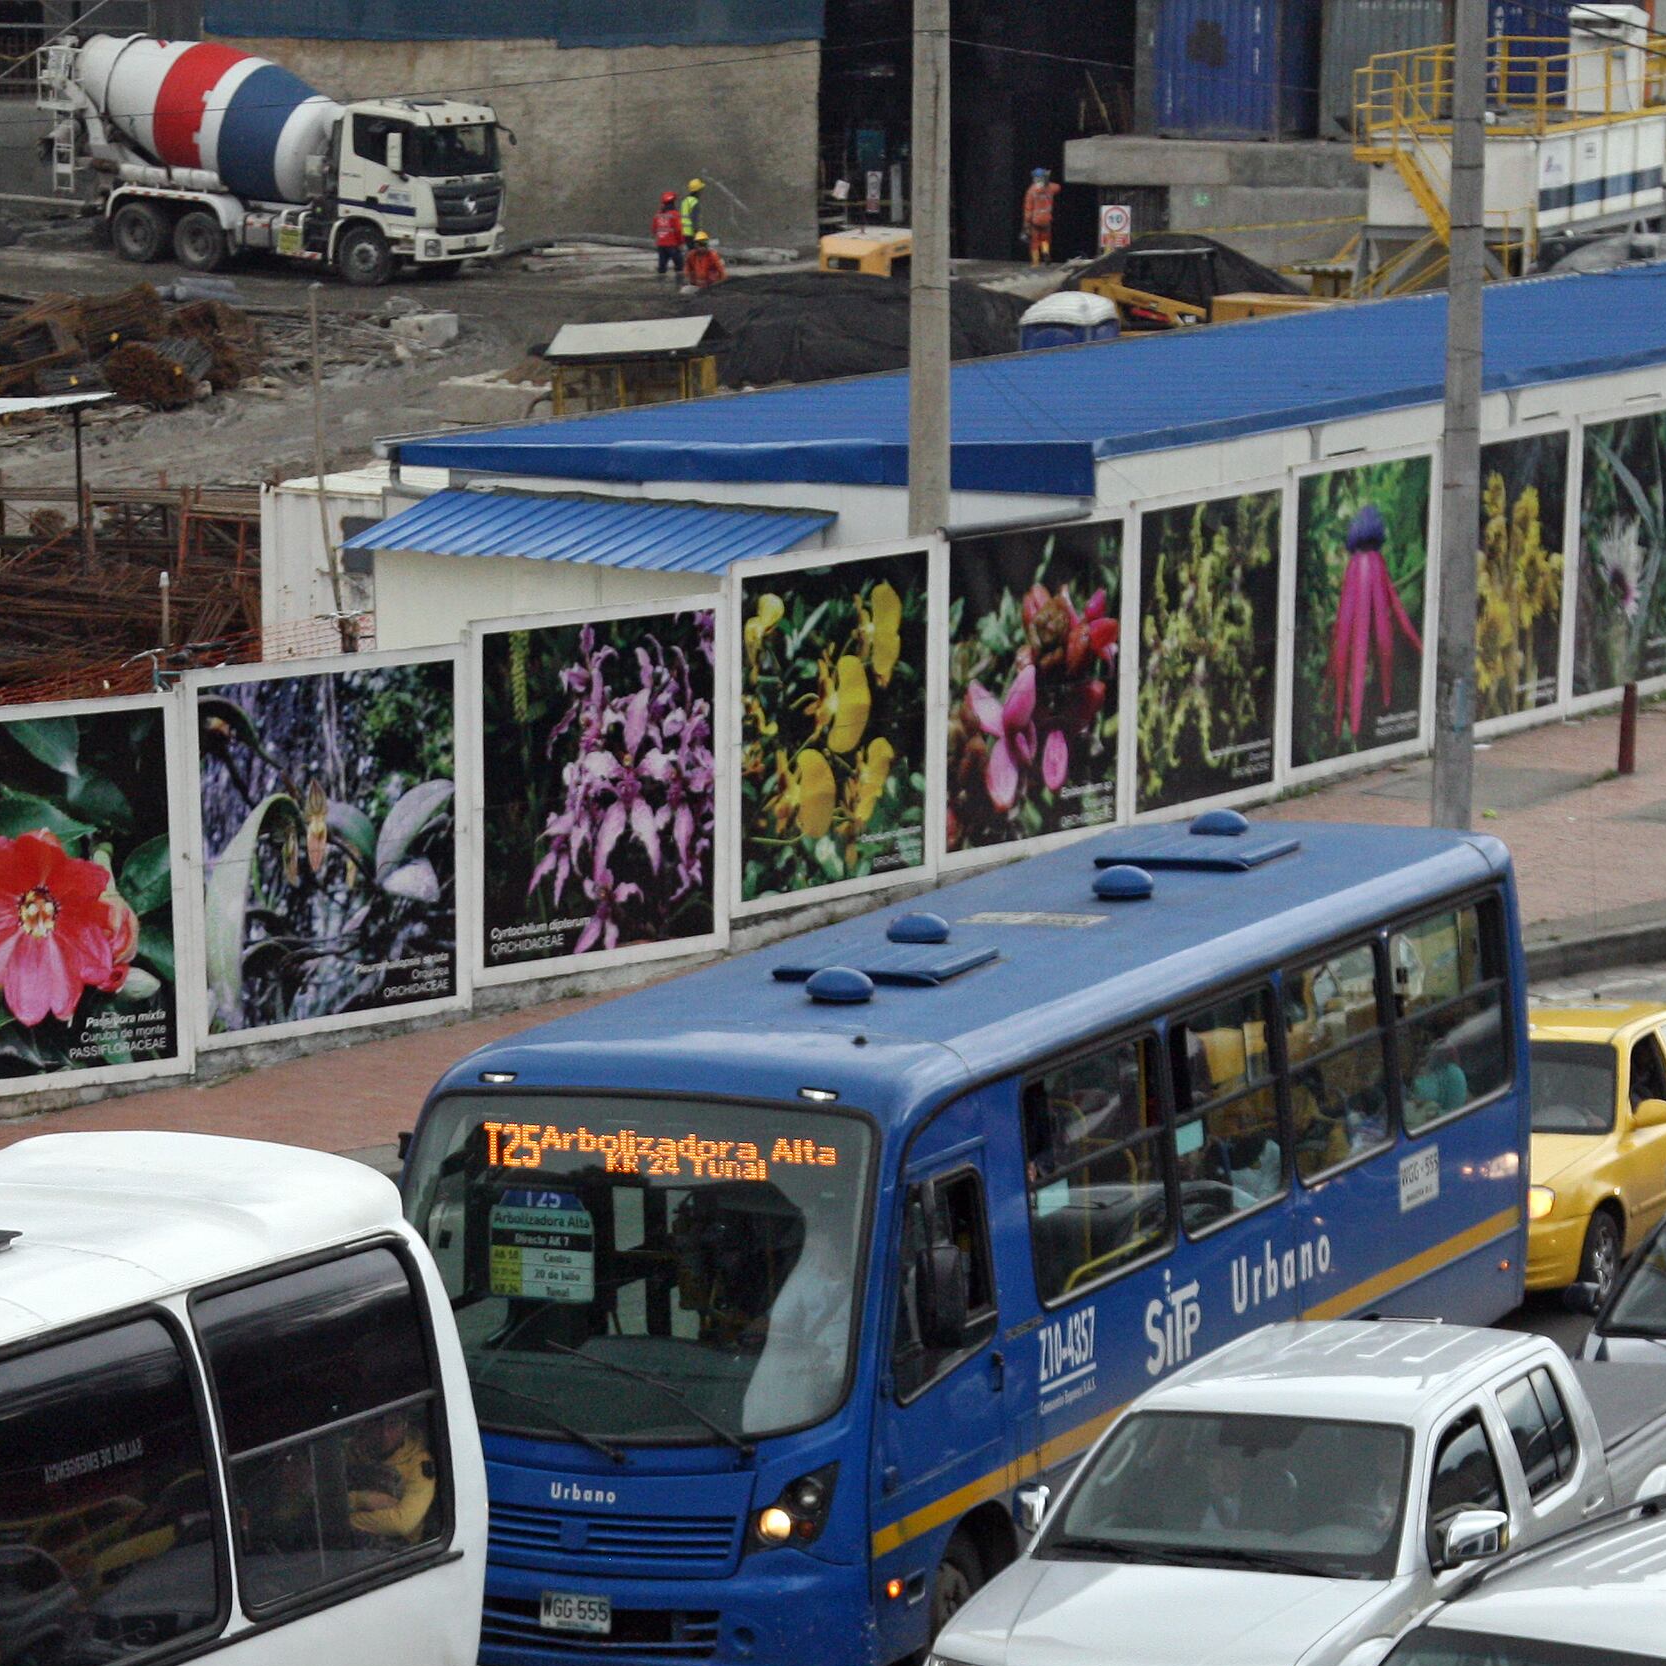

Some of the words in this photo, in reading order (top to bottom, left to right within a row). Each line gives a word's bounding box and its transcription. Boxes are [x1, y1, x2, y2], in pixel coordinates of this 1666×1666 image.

[491, 934, 564, 955] ORCHIDACEAE
[383, 978, 450, 998] ORCHIDACEAE
[137, 1009, 166, 1024] mixta
[80, 1029, 118, 1044] Curuba
[119, 1026, 134, 1039] de
[135, 1024, 166, 1038] monte
[69, 1037, 166, 1060] PASSIFLORACEAE
[483, 1121, 542, 1168] T25
[540, 1124, 758, 1160] Arbolizadora
[770, 1136, 837, 1167] Alta
[691, 1153, 768, 1181] Tunal
[568, 1215, 591, 1229] Alta
[1232, 1234, 1331, 1314] Urbano
[550, 1481, 616, 1504] Urbano
